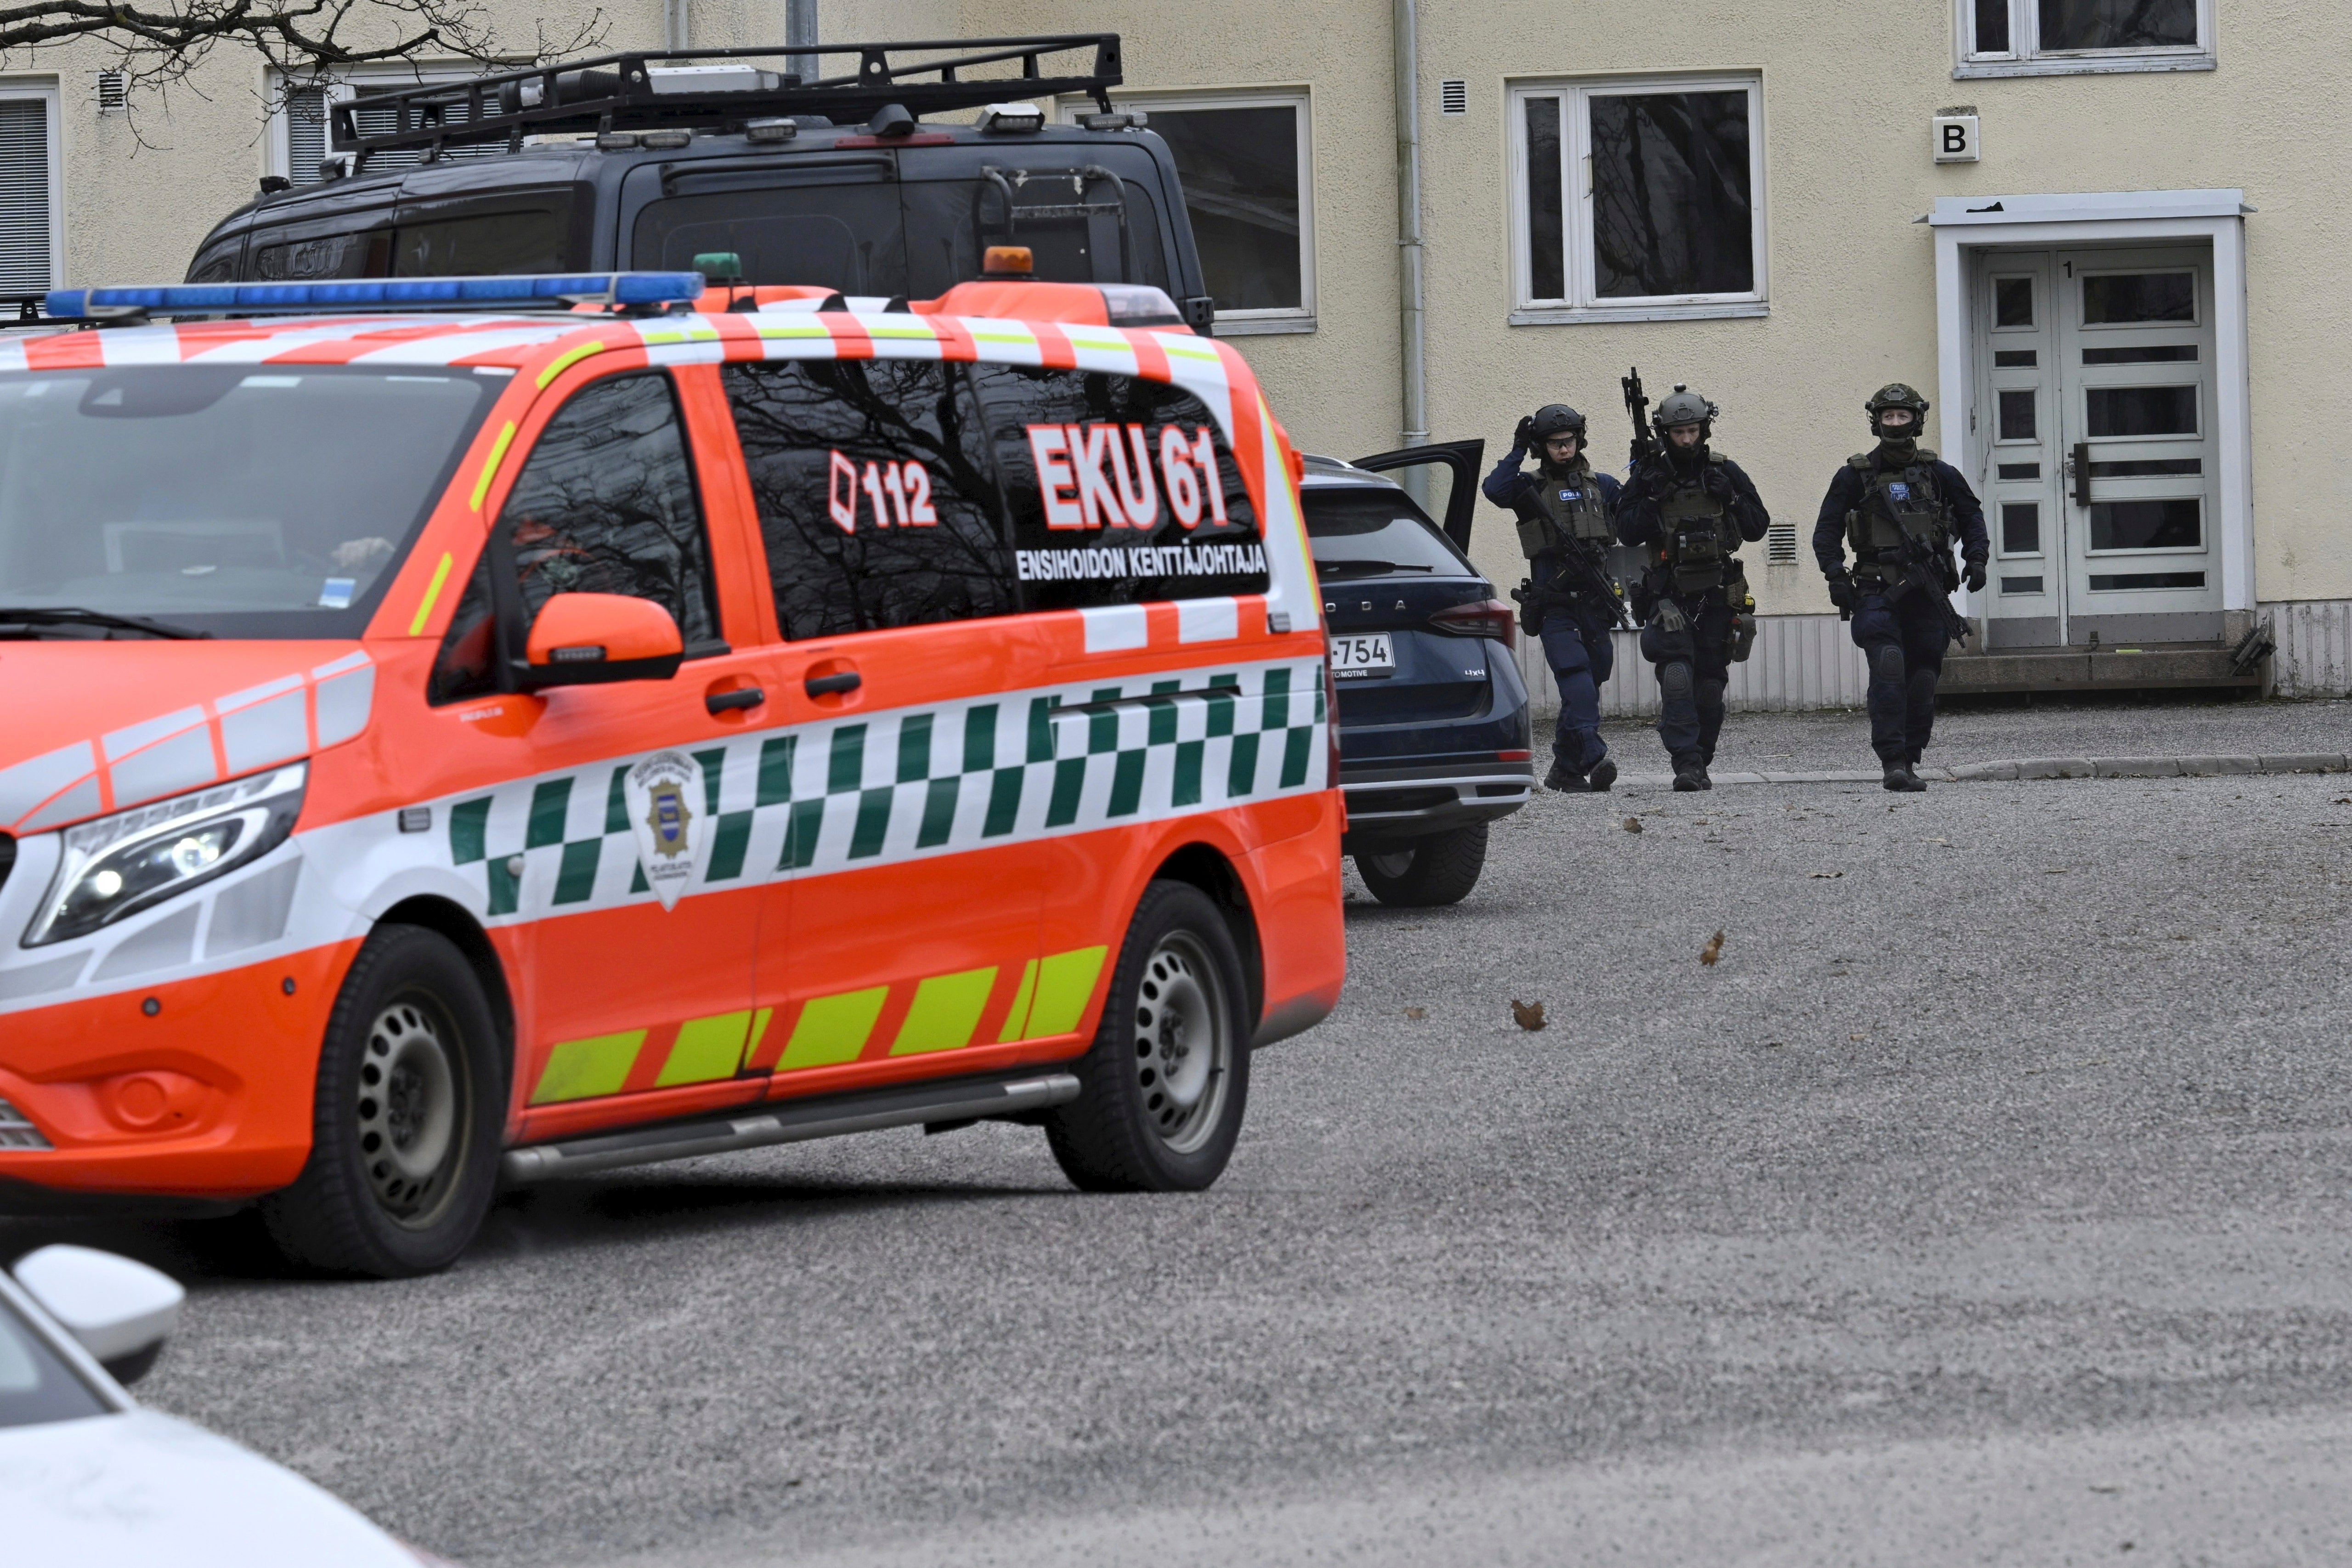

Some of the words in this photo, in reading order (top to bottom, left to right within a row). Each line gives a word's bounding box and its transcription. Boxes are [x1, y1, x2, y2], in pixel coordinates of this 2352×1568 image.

[1943, 125, 1966, 153] B
[2063, 260, 2072, 278] 1
[1026, 423, 1158, 530] EKU
[1159, 424, 1228, 530] 61
[860, 459, 938, 528] 112
[1015, 549, 1127, 581] ENSIHOIDON
[1128, 538, 1267, 577] KENTTÄJOHTAJA
[1325, 600, 1406, 612] ODA
[1330, 639, 1387, 665] -754
[1331, 669, 1368, 678] TOMOTIVE
